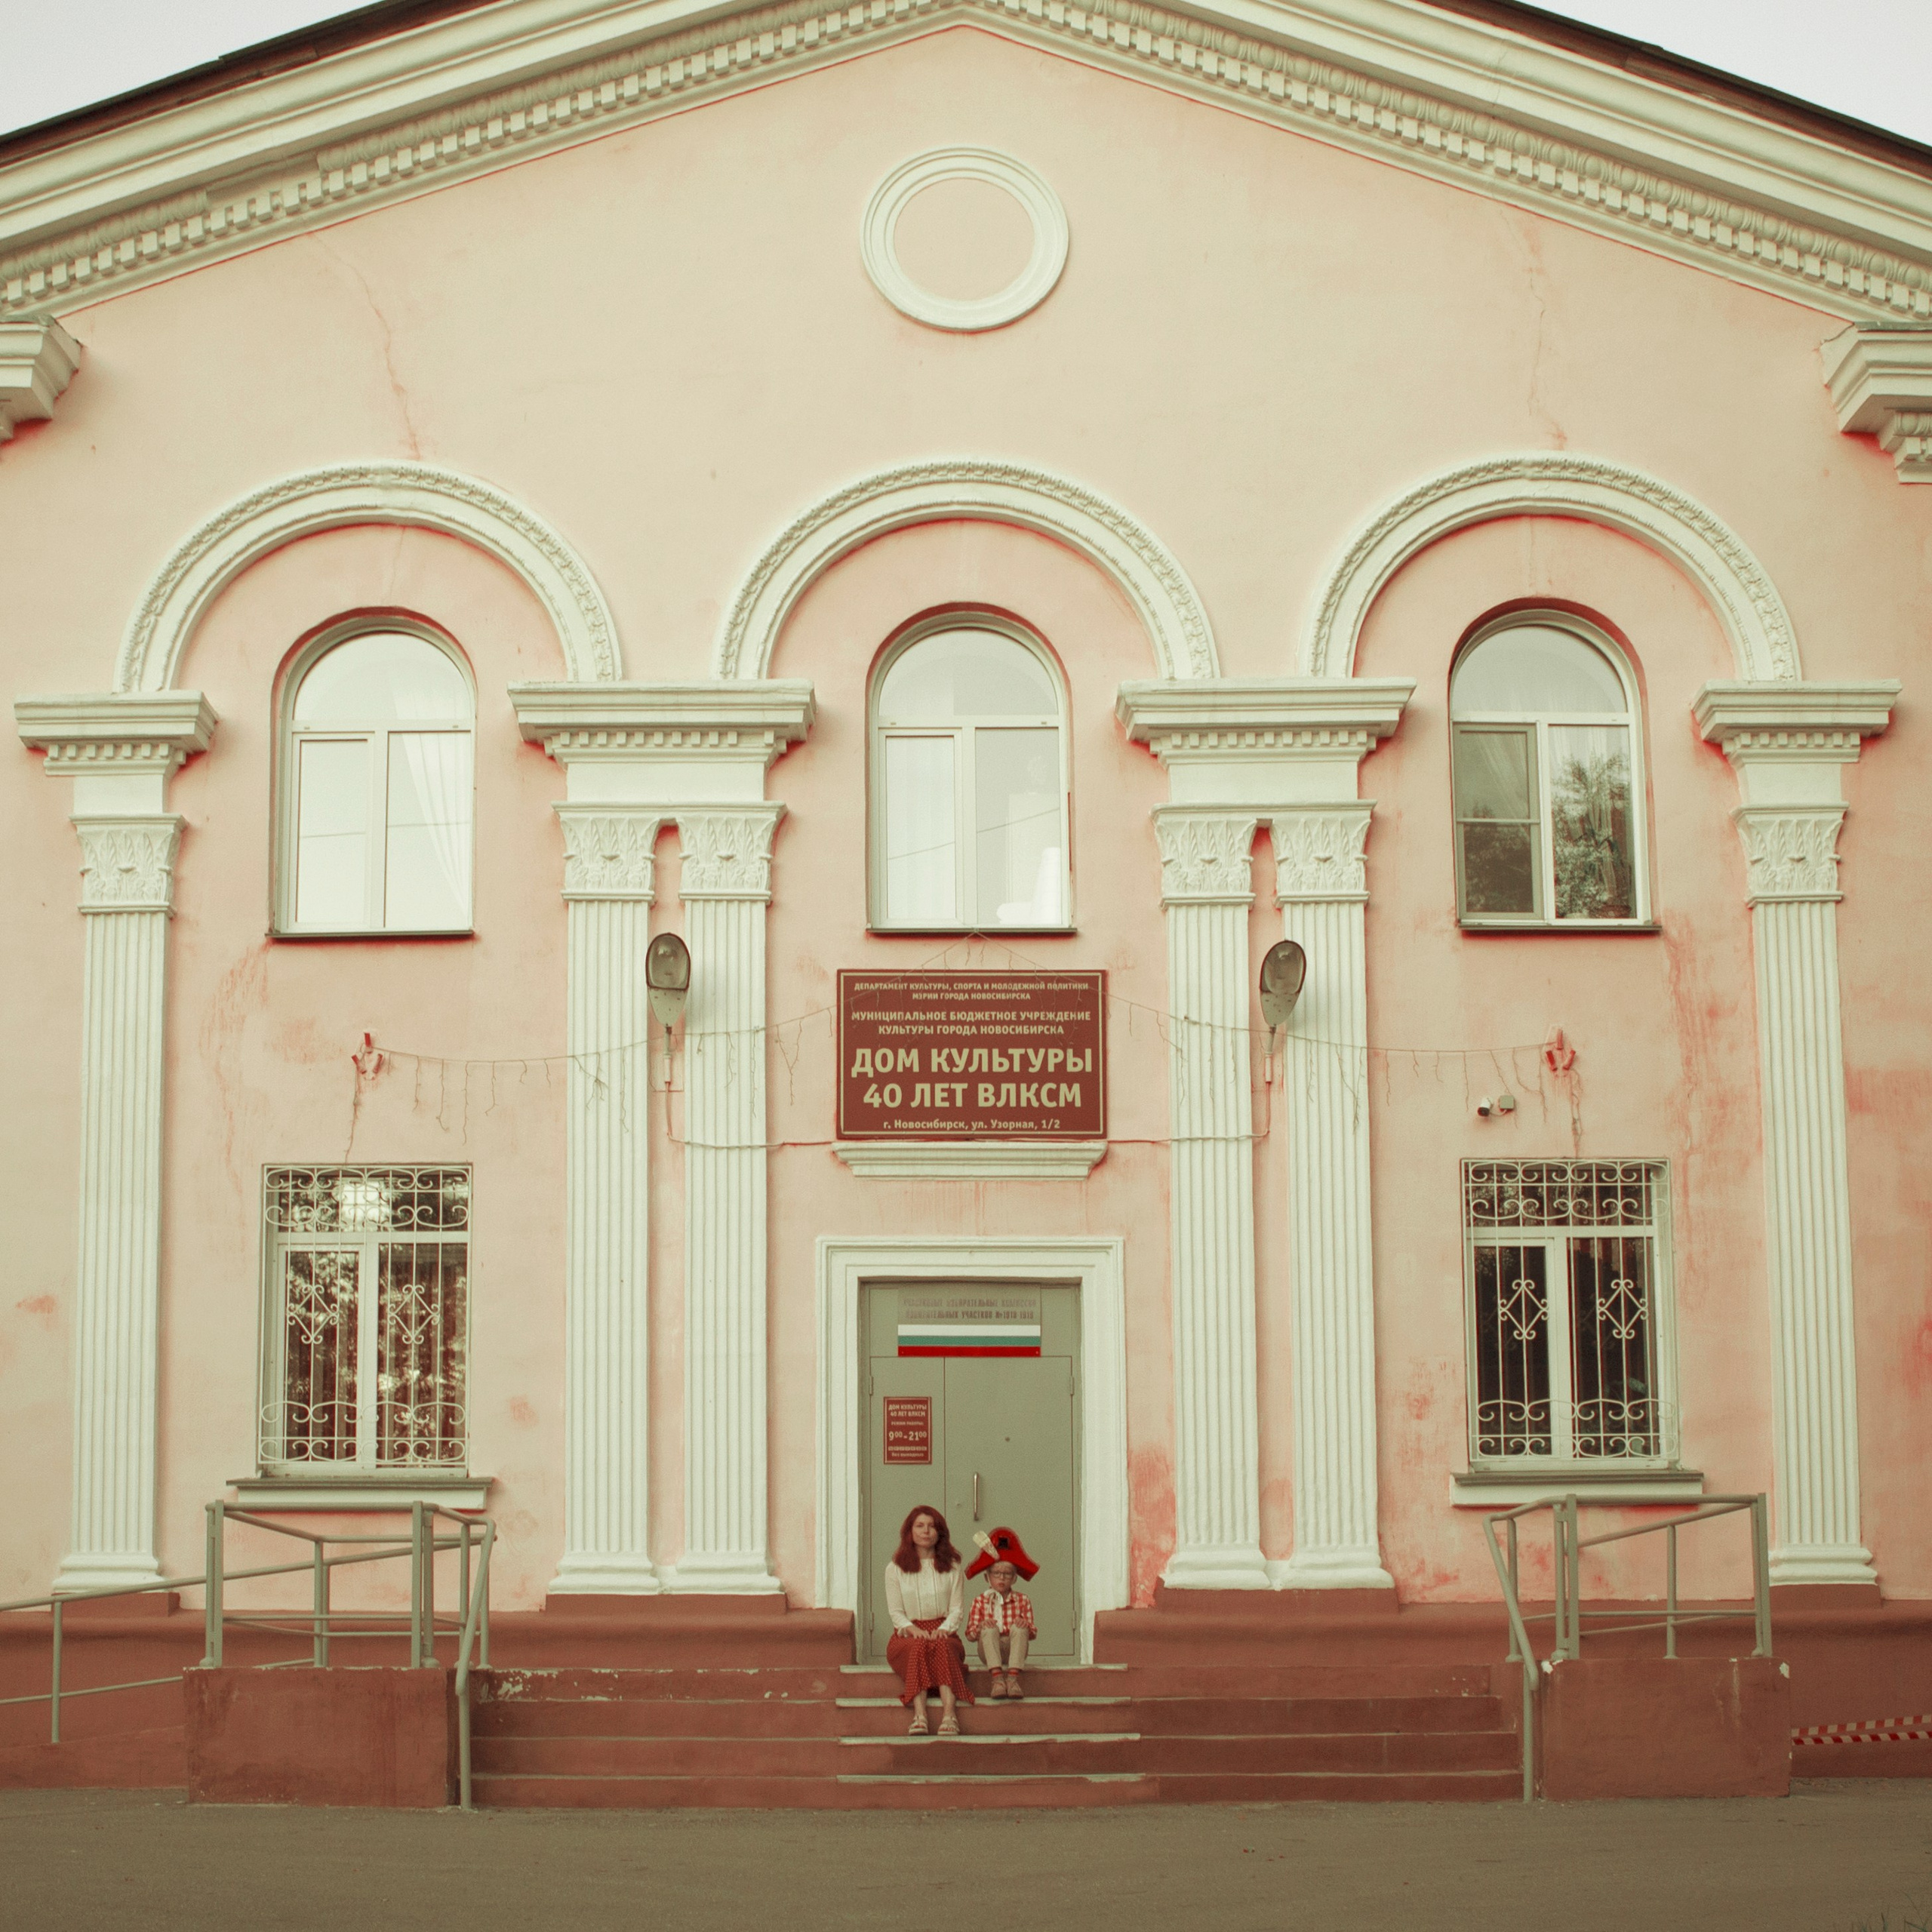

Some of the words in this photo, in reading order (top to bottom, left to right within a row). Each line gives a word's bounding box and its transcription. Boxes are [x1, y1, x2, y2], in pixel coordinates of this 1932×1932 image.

[854, 983, 908, 991] ДЕПАРТАМЕНТ
[909, 983, 952, 991] КУЛЬТУРЫ,
[991, 981, 1045, 991] МОЛОДЕЖНОЙ
[940, 992, 969, 1001] ГОРОДА
[851, 1011, 946, 1022] МУНИЦИПАЛЬНОЕ
[949, 1011, 1017, 1022] БЮДЖЕТНОЕ
[1020, 1011, 1091, 1022] УЧРЕЖДЕНИЕ
[878, 1026, 934, 1035] КУЛЬТУРЫ
[937, 1026, 977, 1036] ГОРОДА
[980, 1026, 1064, 1035] НОВОСИБИРСКА
[851, 1048, 919, 1078] ДОМ
[931, 1048, 1092, 1072] КУЛЬТУРЫ
[863, 1083, 903, 1108] 40
[910, 1083, 968, 1108] ЛЕТ
[978, 1082, 1081, 1108] ВЛКСМ
[894, 1118, 968, 1131] Новосибирск,
[971, 1121, 988, 1131] ул.
[990, 1119, 1038, 1130] Узорная,
[1041, 1118, 1060, 1129] 1/2
